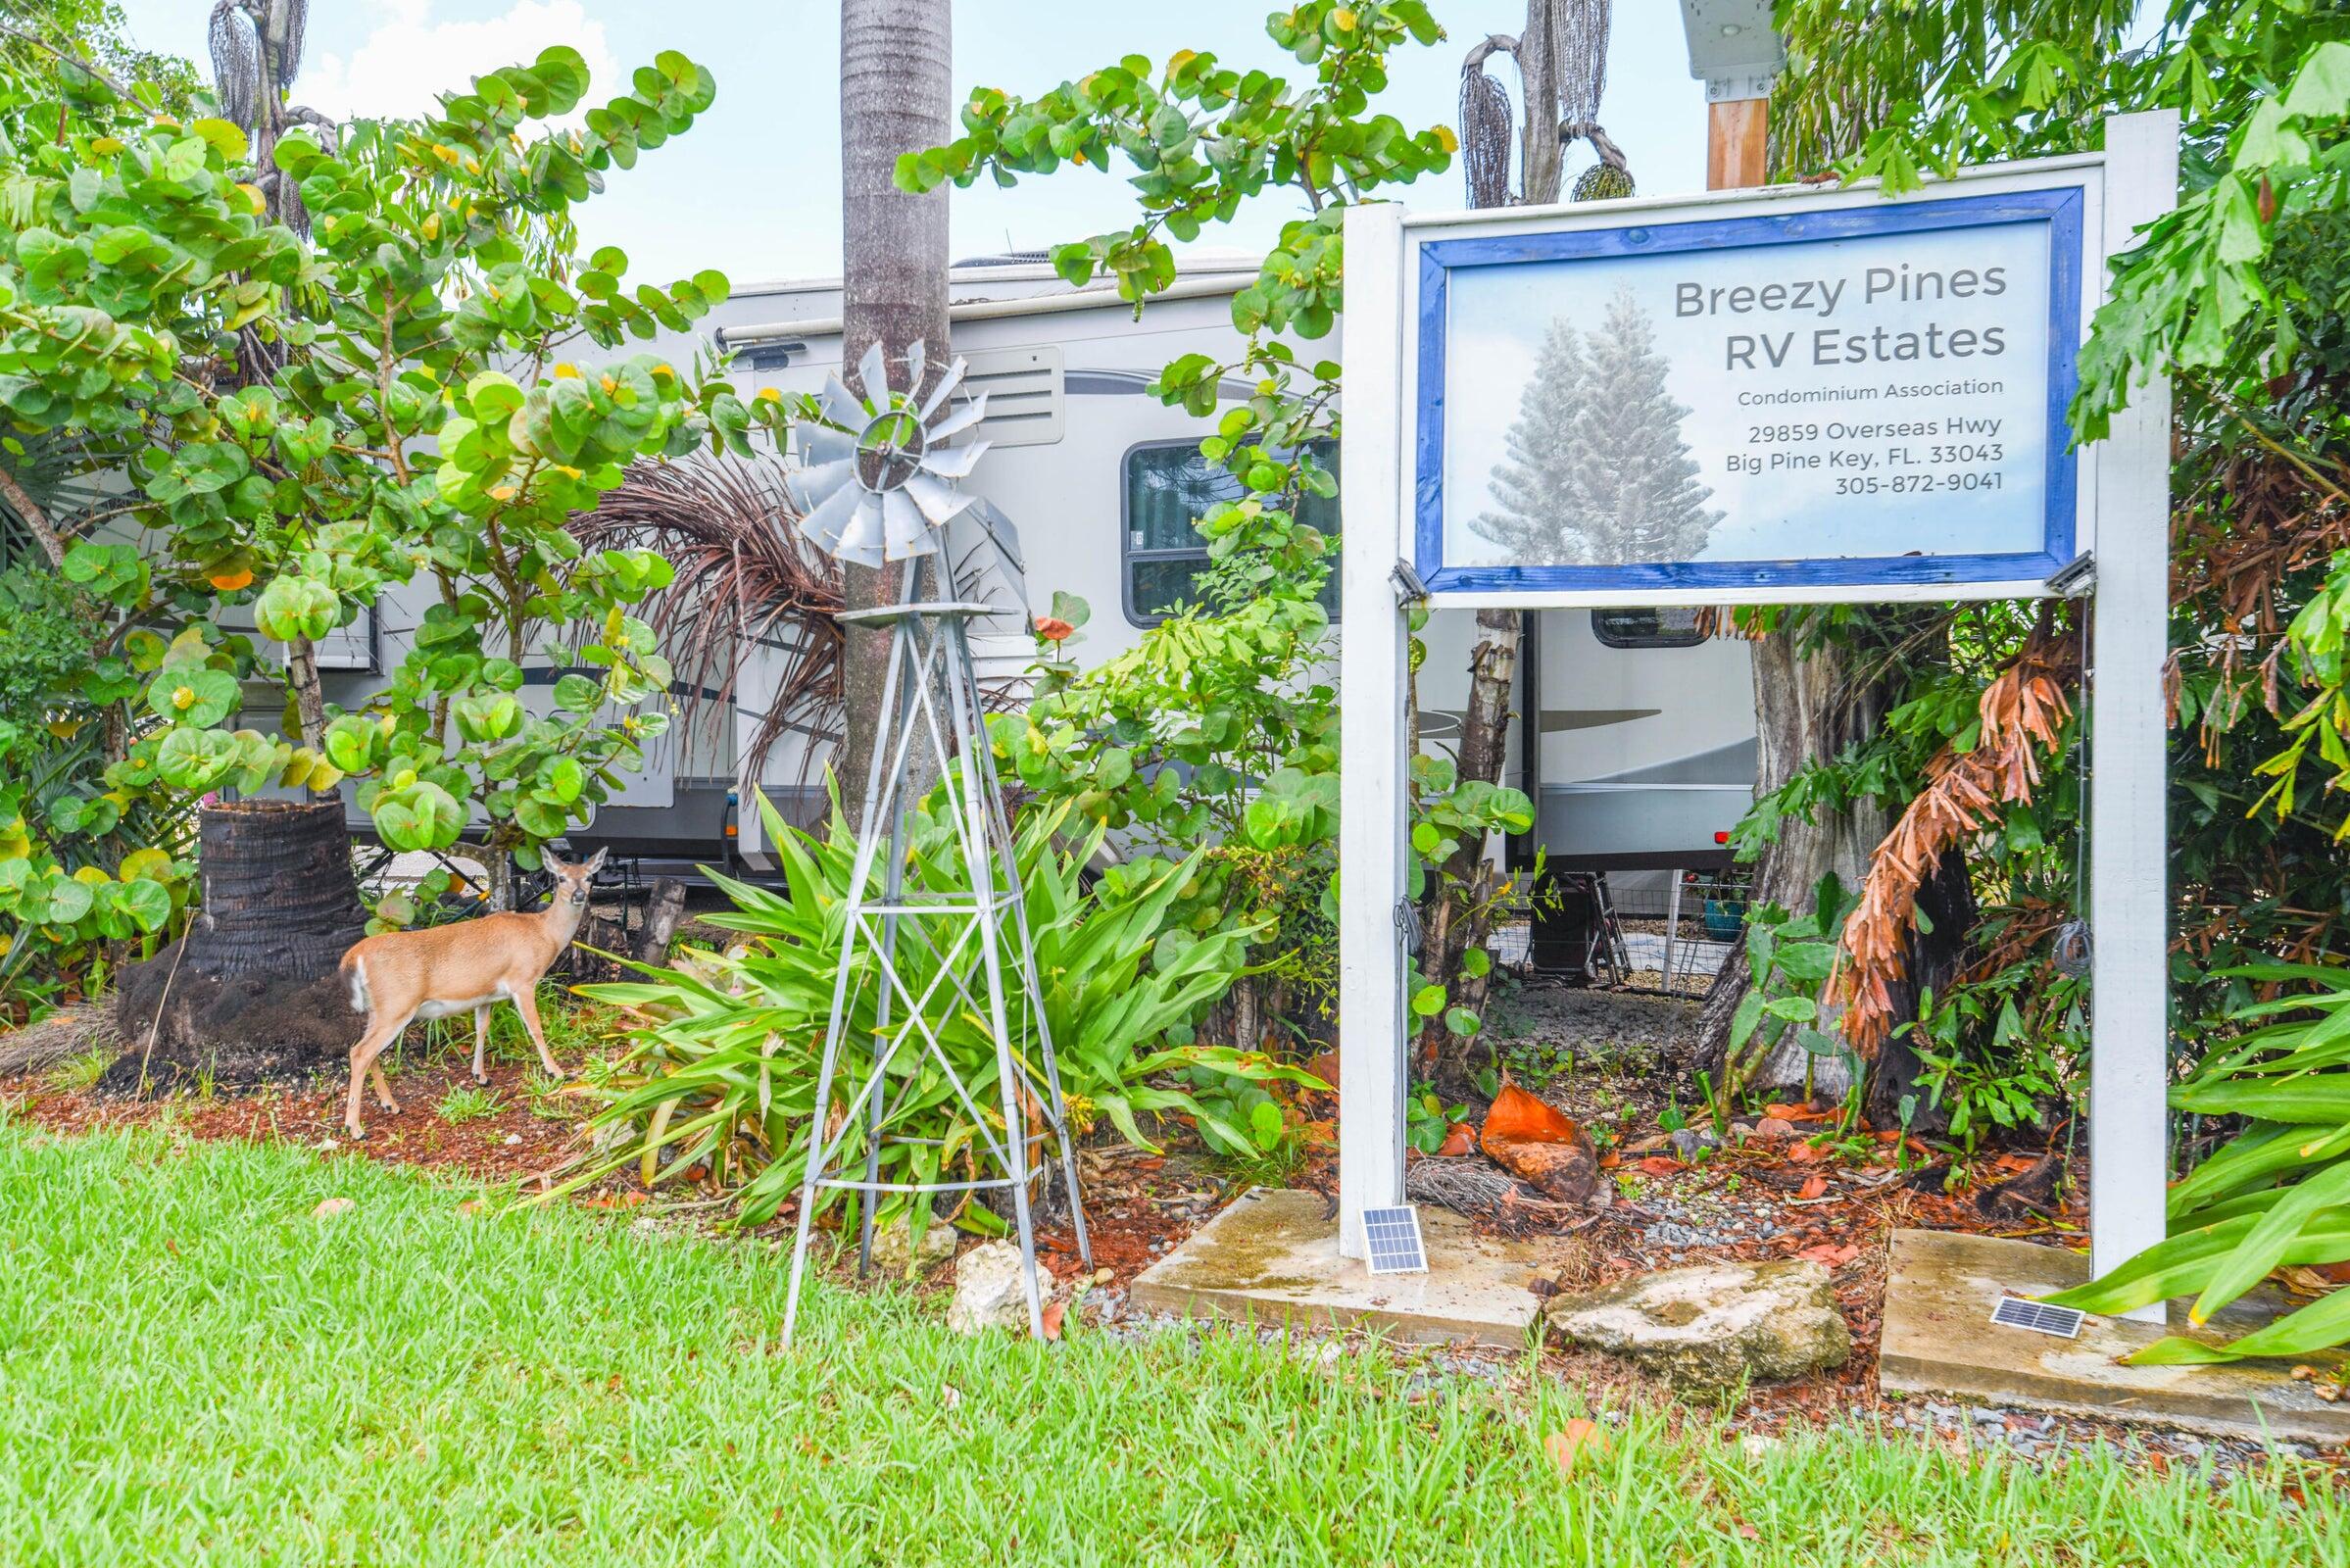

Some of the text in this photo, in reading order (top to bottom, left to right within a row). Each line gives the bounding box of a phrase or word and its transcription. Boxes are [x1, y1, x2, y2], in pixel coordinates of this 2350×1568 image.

[1675, 262, 2007, 318] Breezy Pines
[1726, 321, 2006, 371] RV Estates
[1738, 378, 2004, 407] Condominium Association
[1748, 416, 2003, 444] 29859 Overseas Hwy
[1726, 443, 2004, 476] Big Pine Key, FL. 33043
[1835, 471, 2002, 496] 305-872-9041
